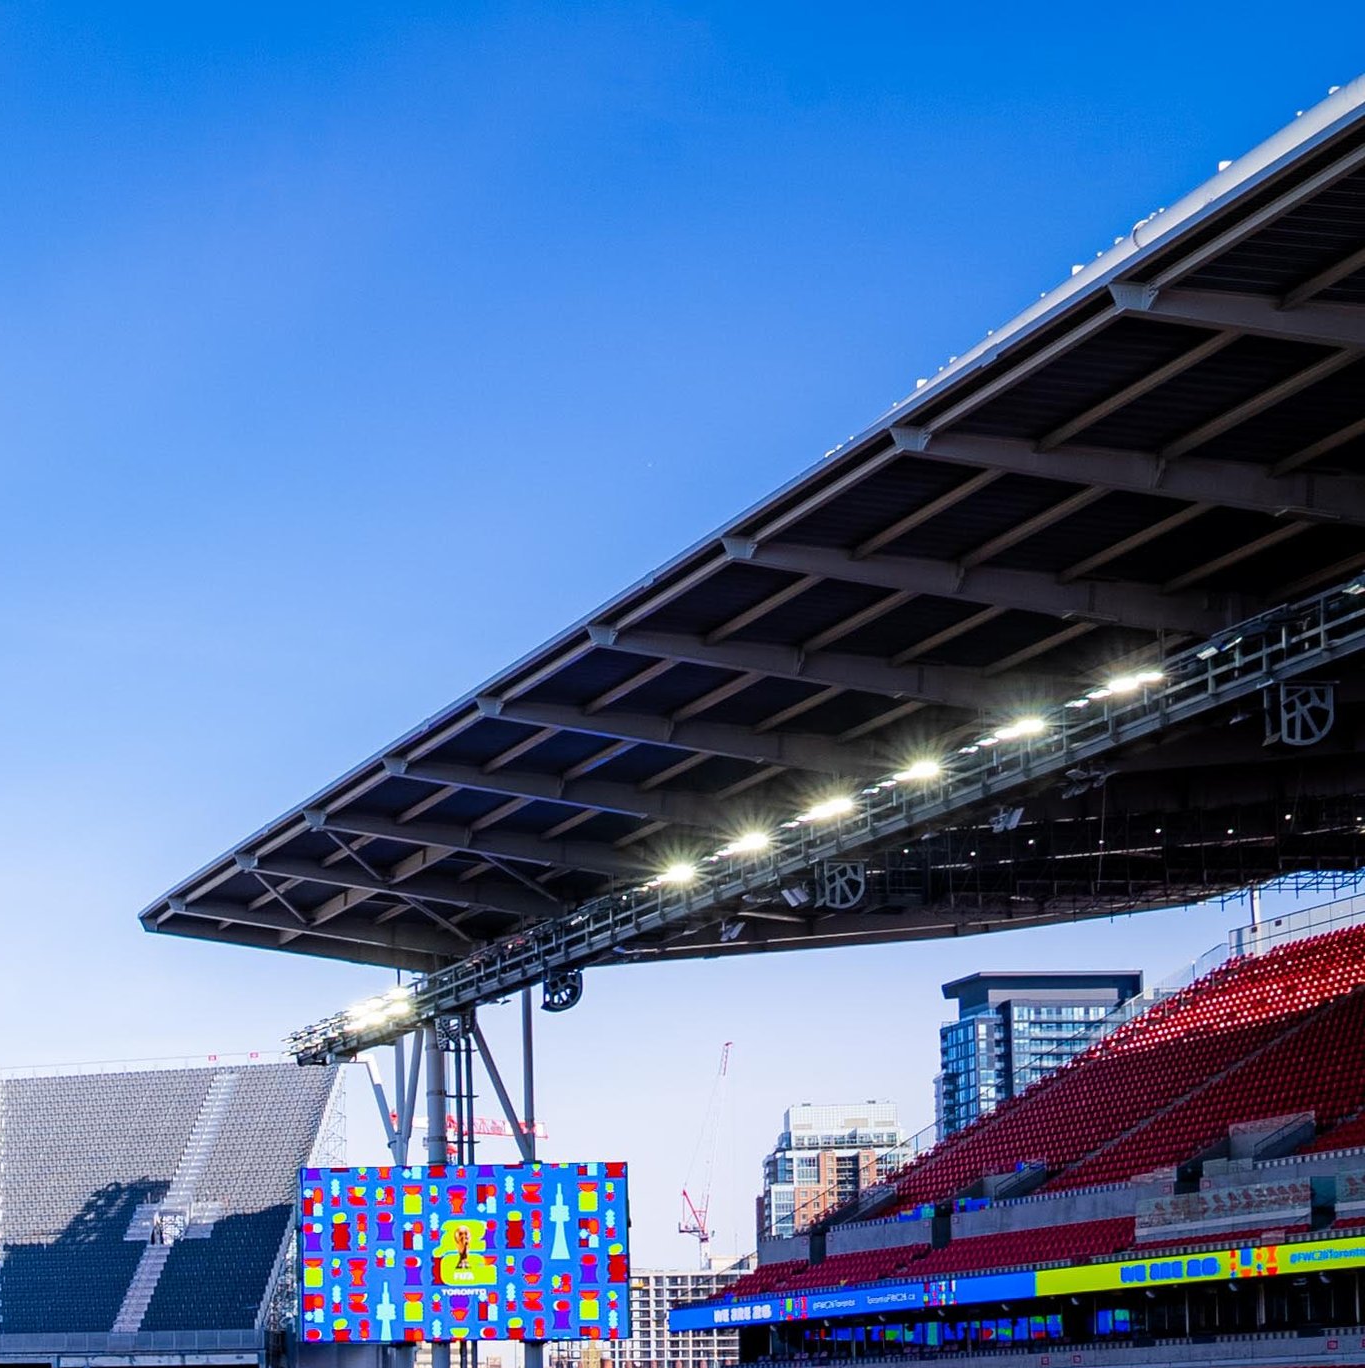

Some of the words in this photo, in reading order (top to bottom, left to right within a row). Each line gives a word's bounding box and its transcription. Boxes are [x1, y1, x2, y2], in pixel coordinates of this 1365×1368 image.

[453, 1271, 475, 1280] FIFA
[1120, 1264, 1146, 1283] WE
[1149, 1260, 1183, 1280] ARE
[1186, 1256, 1218, 1277] 26
[441, 1288, 487, 1296] TORONTO
[714, 1309, 729, 1323] WE
[731, 1306, 751, 1321] ARE
[752, 1304, 772, 1319] 26
